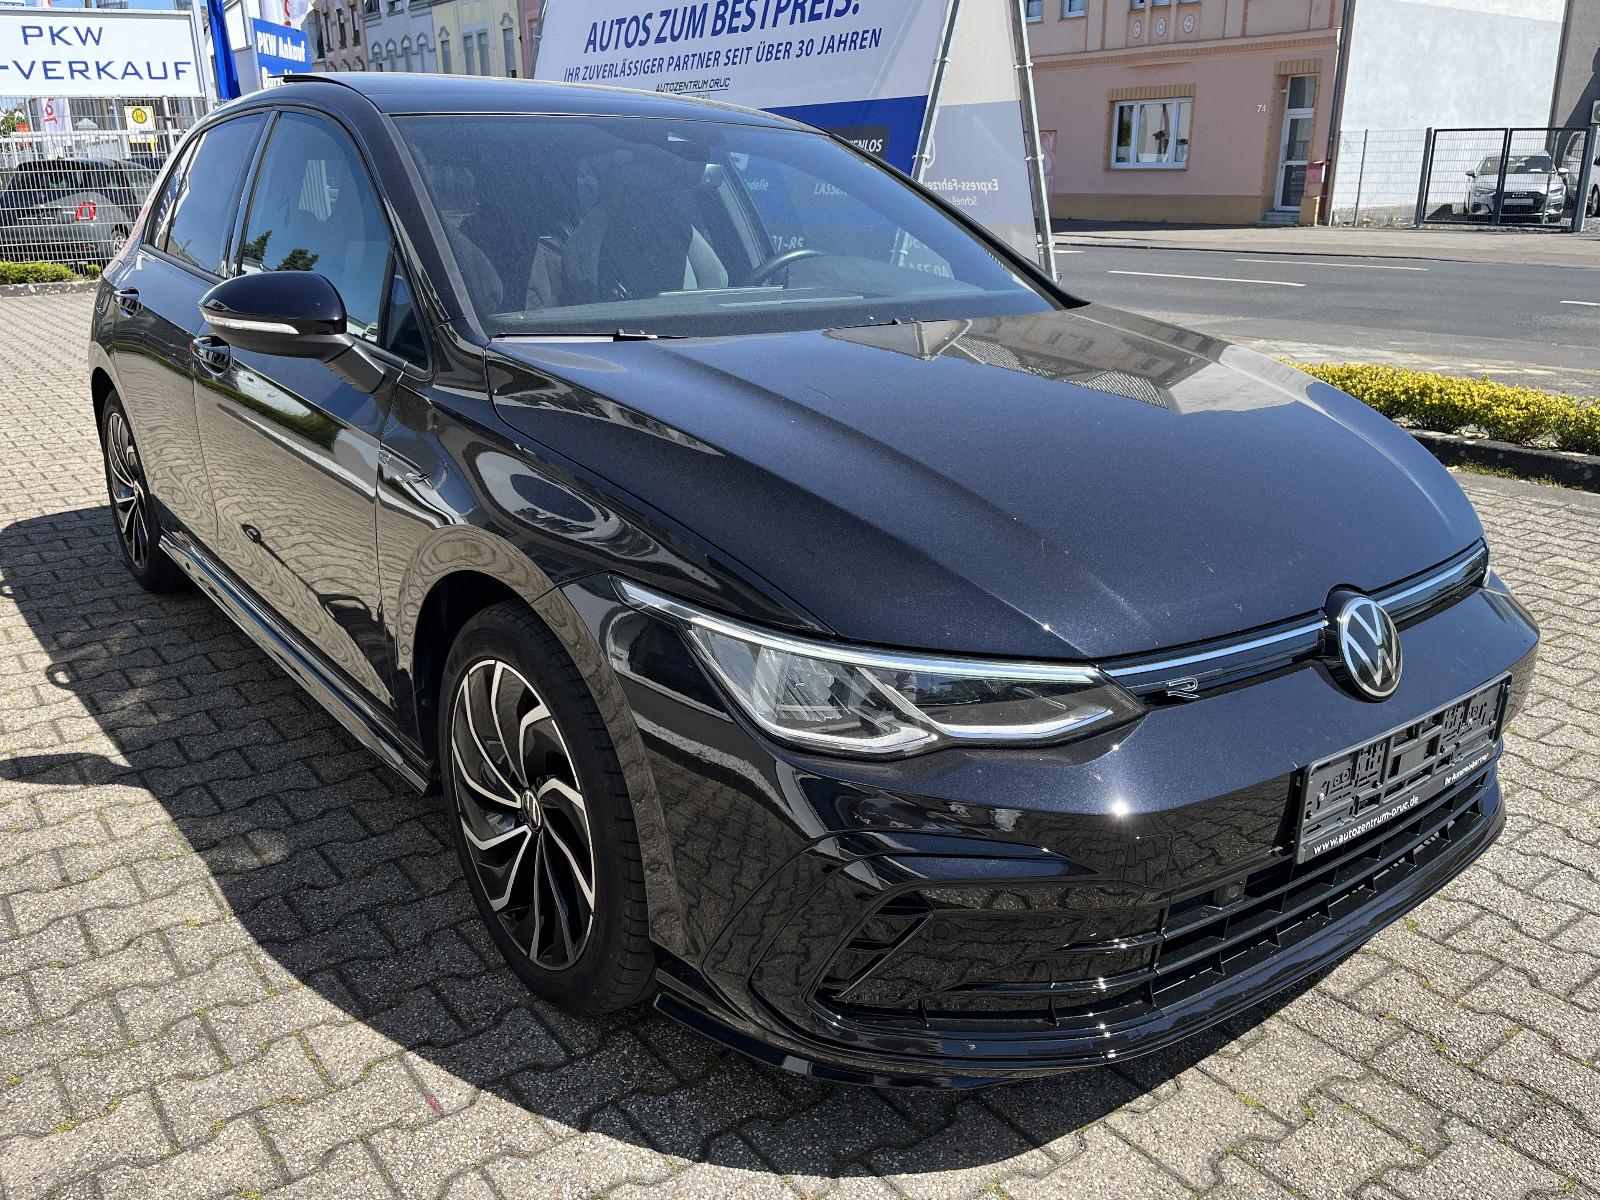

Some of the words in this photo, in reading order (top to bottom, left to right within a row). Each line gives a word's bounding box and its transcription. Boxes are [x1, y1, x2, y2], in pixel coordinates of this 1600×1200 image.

[21, 26, 104, 45] PKW
[584, 13, 652, 53] AUTOS
[655, 6, 706, 43] ZUM
[257, 31, 277, 56] PKW
[563, 67, 581, 82] IHR
[582, 57, 664, 81] ZUVERLÄSSIGER
[666, 50, 720, 73] PARTNER
[724, 47, 752, 66] SEIT
[756, 41, 793, 63] ÜBER
[796, 38, 814, 58] 30
[817, 28, 882, 56] JAHREN
[655, 79, 709, 93] AUTOZENTRUM
[1257, 104, 1267, 113] 74
[1312, 794, 1419, 856] www.autozentrum-oruc.de
